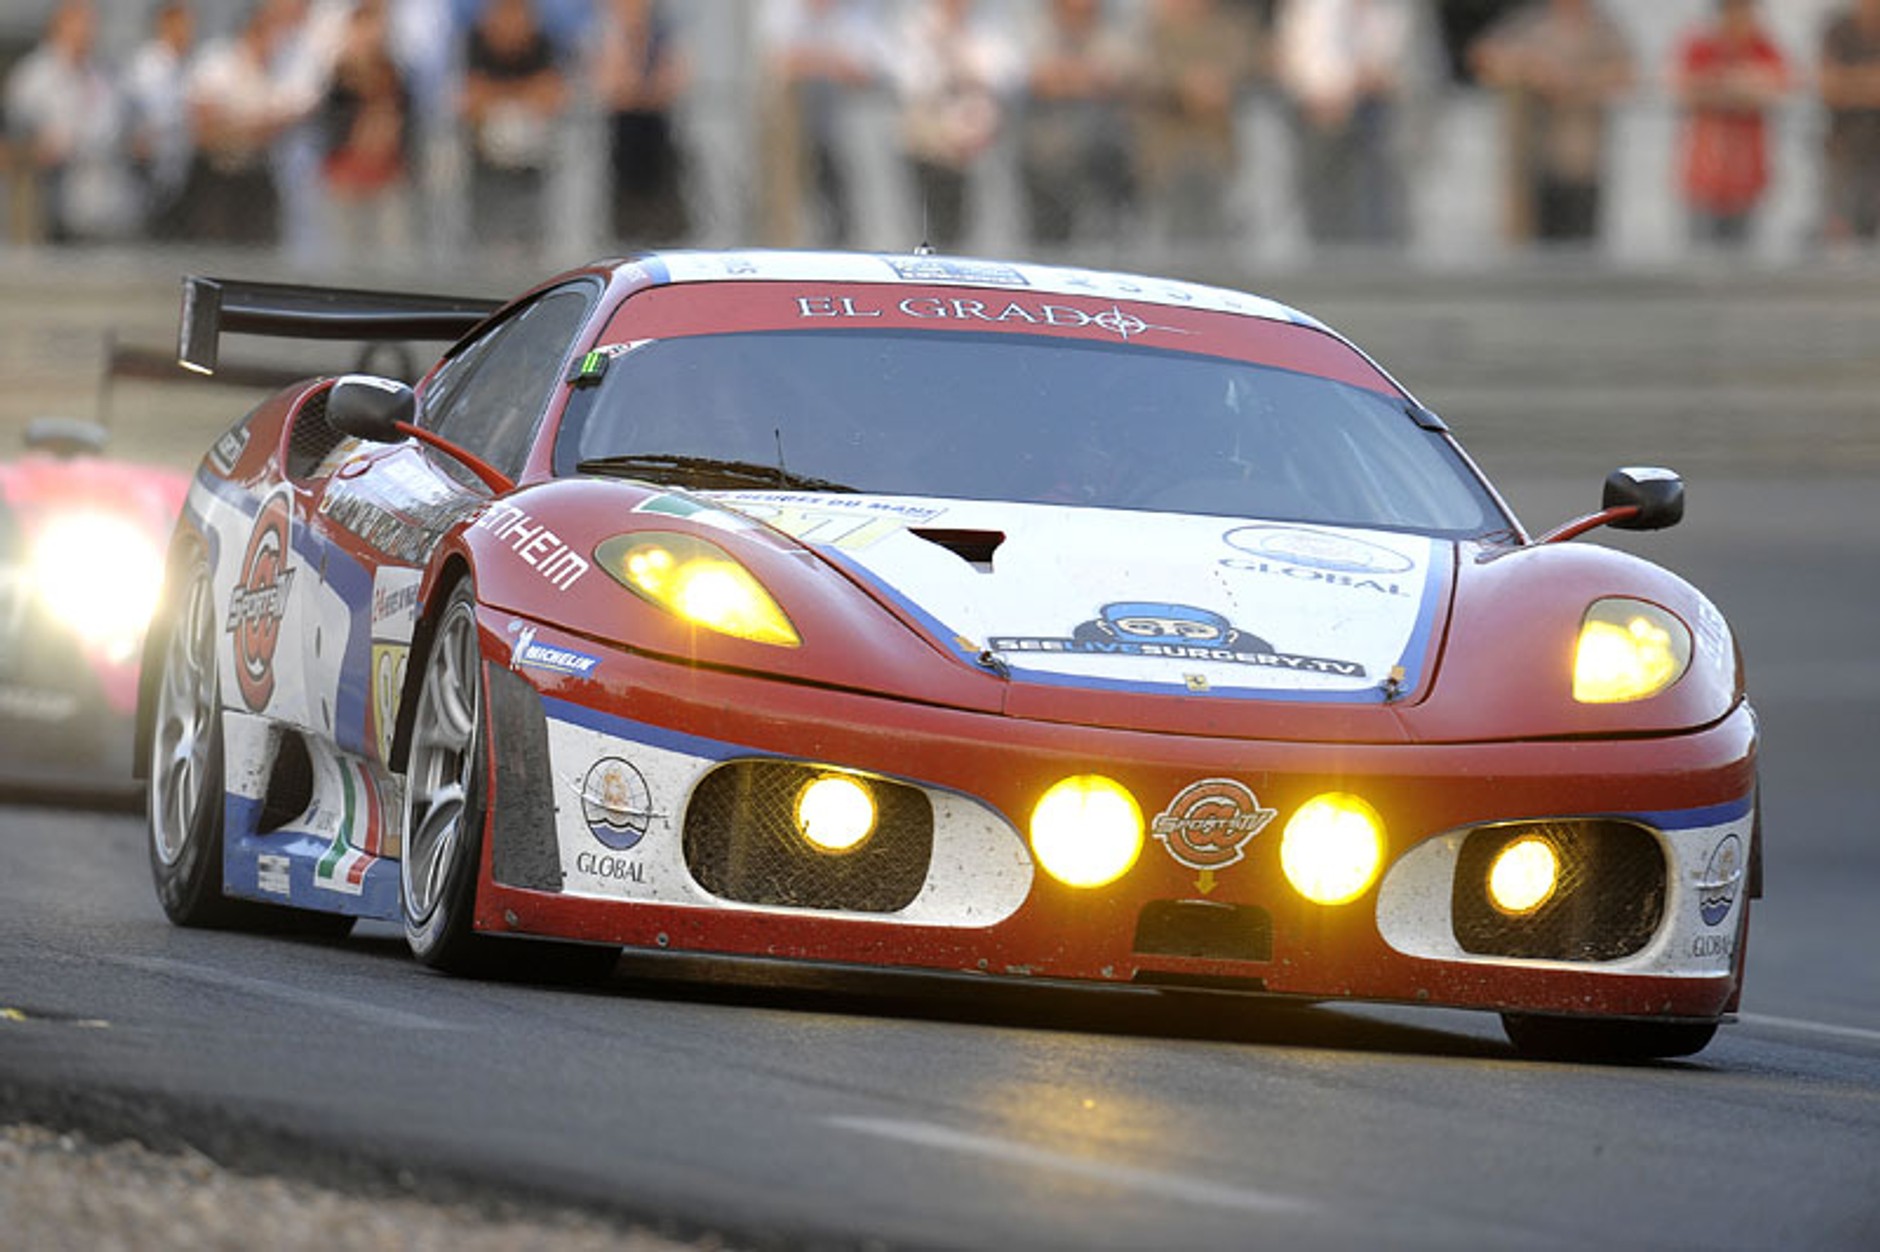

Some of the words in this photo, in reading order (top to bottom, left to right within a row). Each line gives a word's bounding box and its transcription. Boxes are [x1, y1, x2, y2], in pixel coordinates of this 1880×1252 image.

[797, 297, 882, 318] EL
[827, 498, 863, 509] DU
[867, 502, 938, 516] MANS
[1219, 558, 1411, 598] GLOBAL
[526, 645, 596, 671] MICHELIN
[998, 638, 1359, 675] SEELIVESURGERY.TV
[576, 852, 646, 883] GLOBAL
